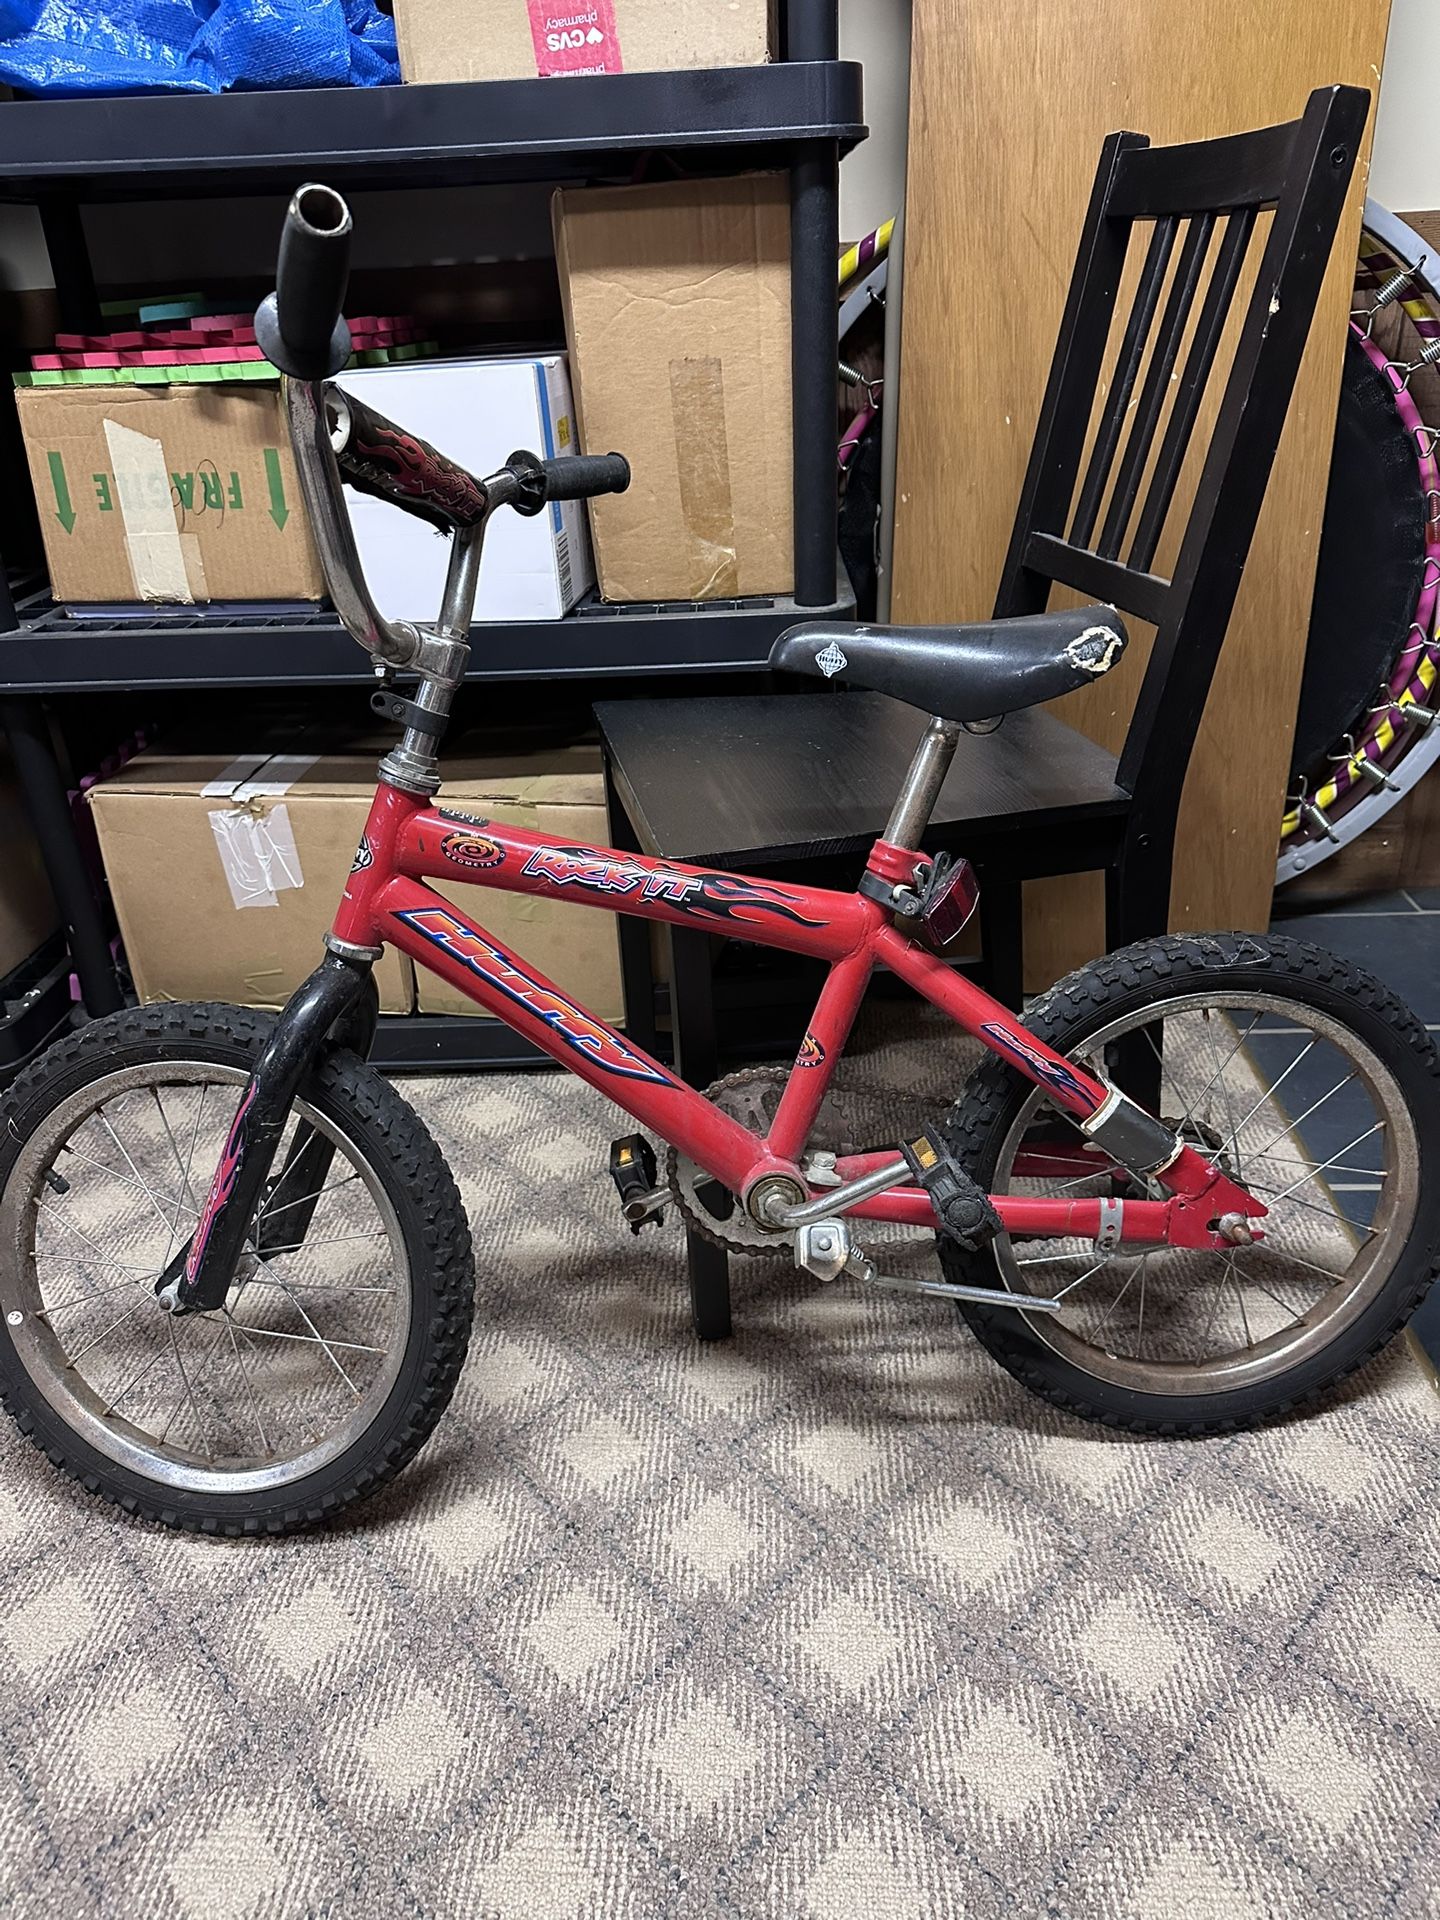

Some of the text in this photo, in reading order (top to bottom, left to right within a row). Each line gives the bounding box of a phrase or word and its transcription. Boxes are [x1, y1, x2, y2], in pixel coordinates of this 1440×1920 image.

[545, 9, 598, 31] pharmacy
[546, 28, 586, 52] CVS
[92, 471, 243, 512] FRAE
[445, 851, 498, 867] GEOMETRY
